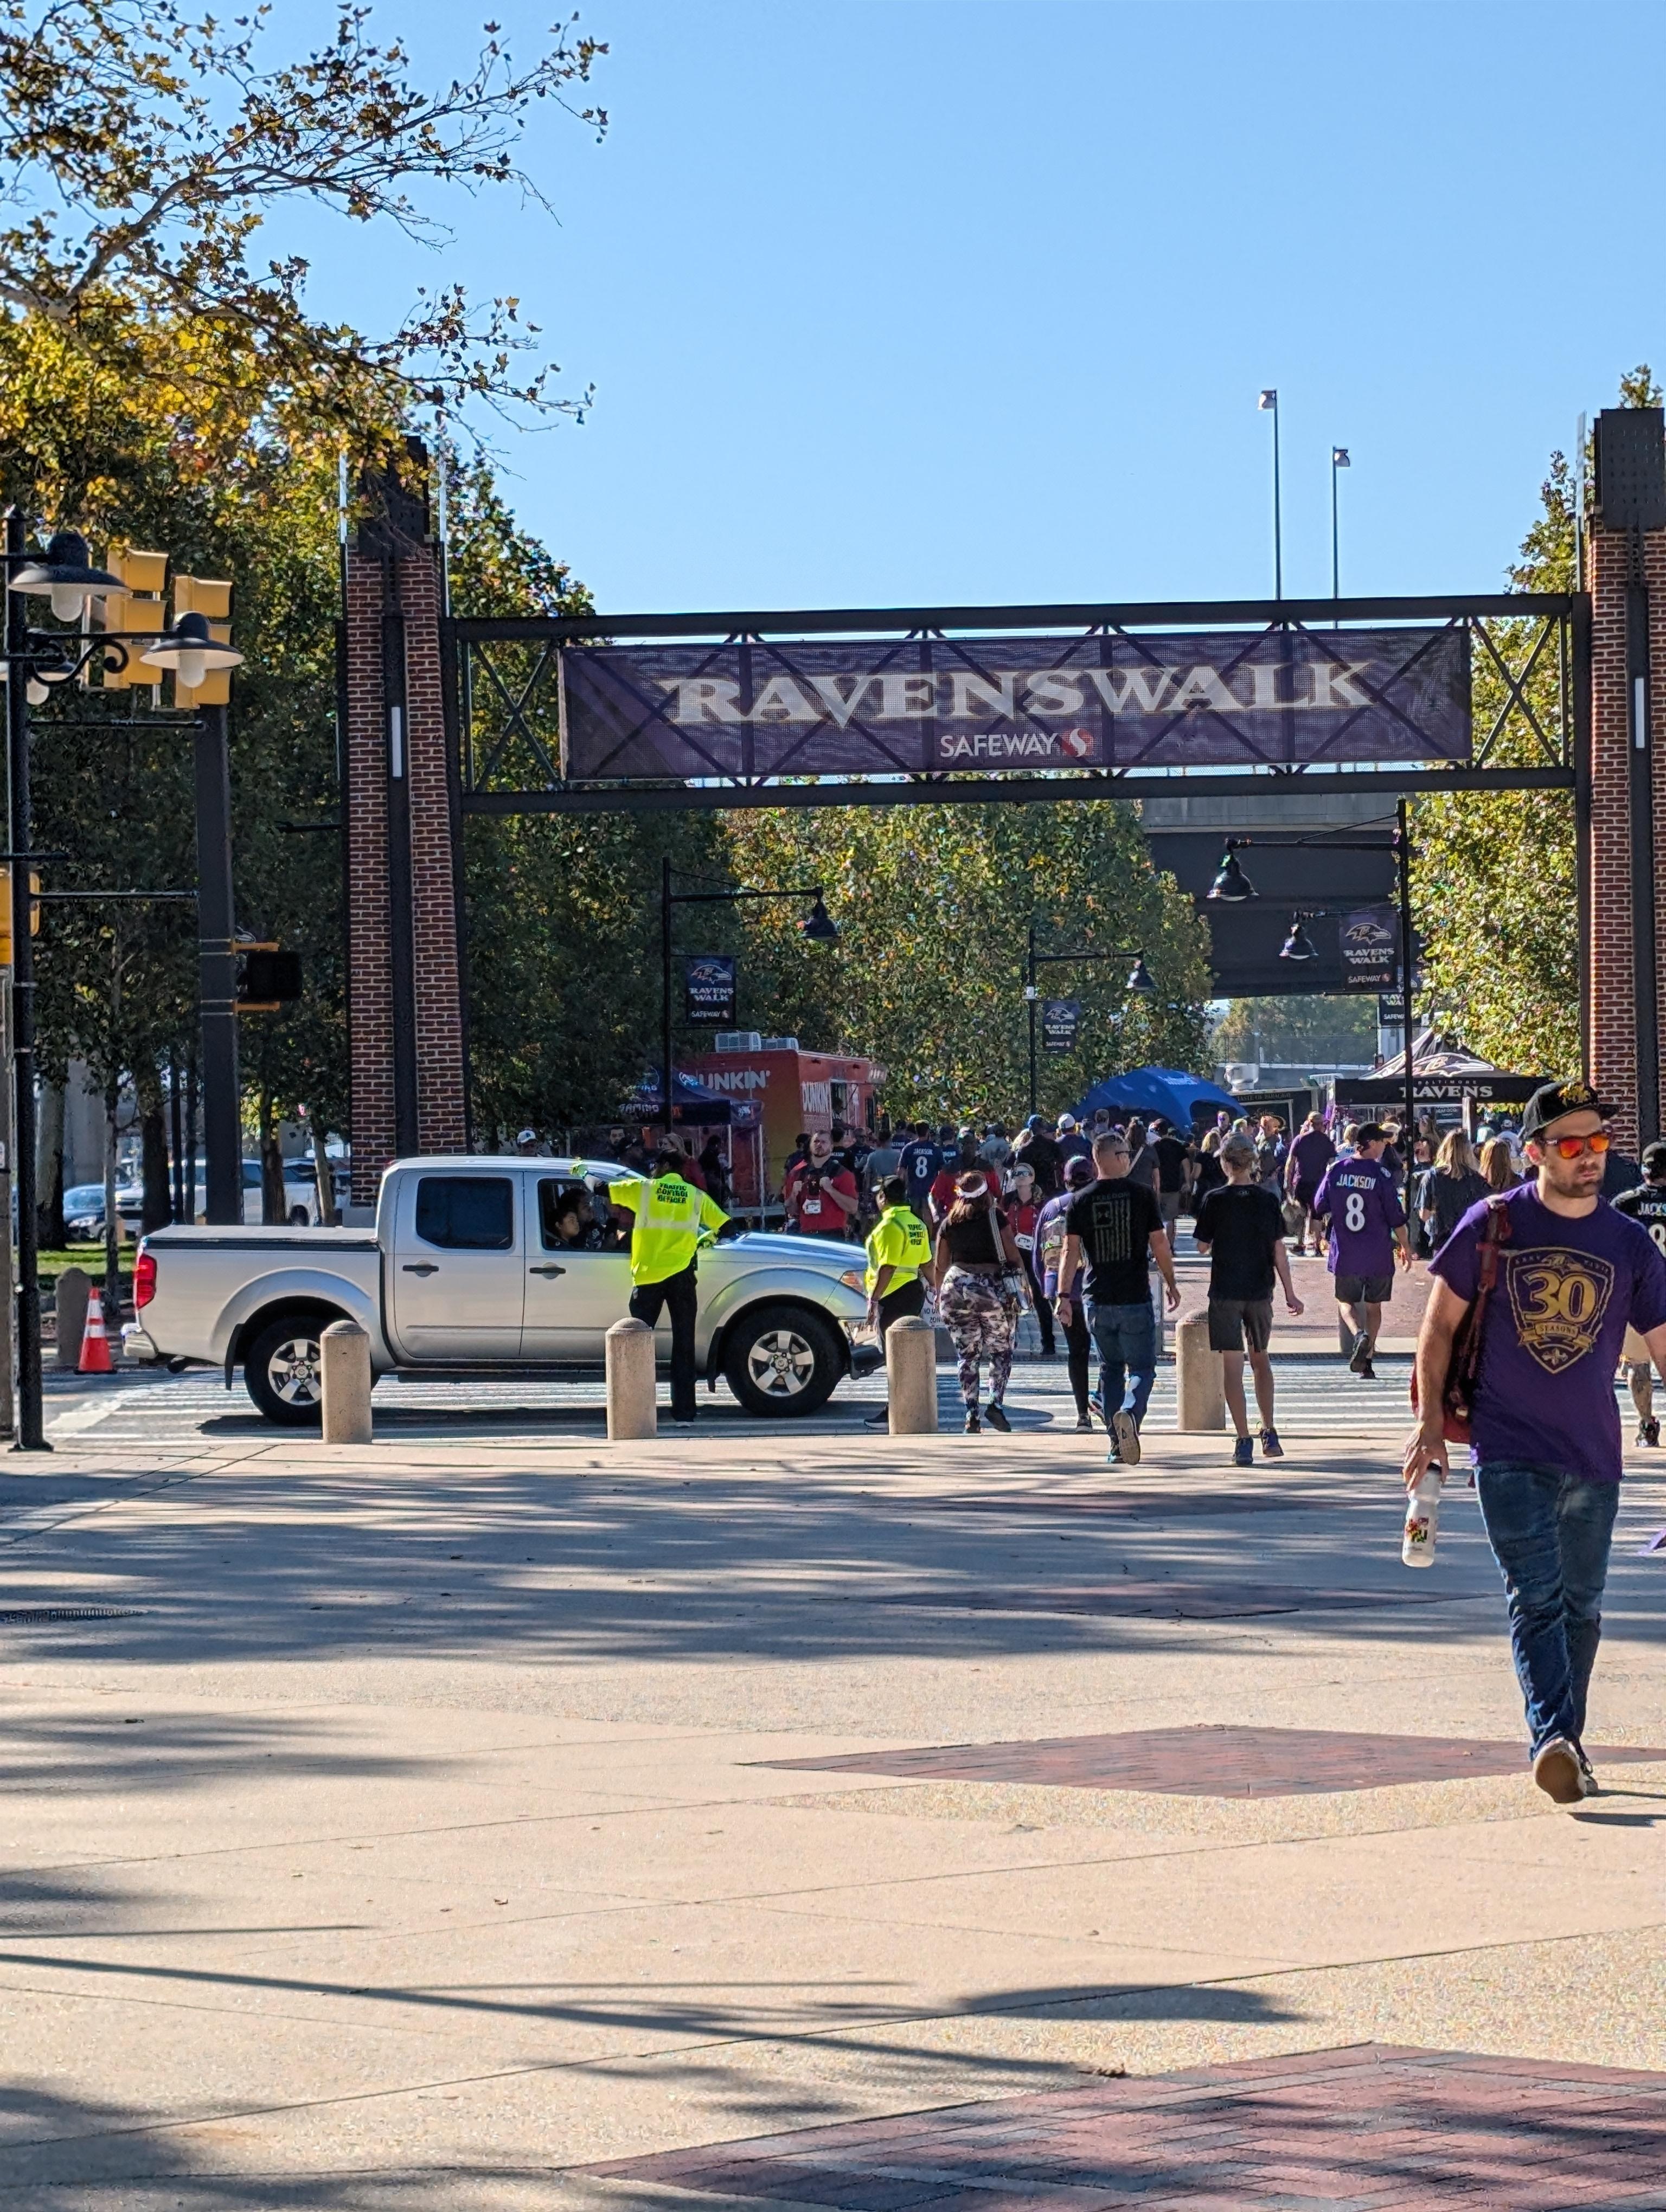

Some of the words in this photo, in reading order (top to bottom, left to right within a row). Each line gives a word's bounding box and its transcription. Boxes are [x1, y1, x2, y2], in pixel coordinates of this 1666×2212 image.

[655, 662, 1376, 728] RAVENSWALK
[940, 732, 1058, 757] SAFEWAY
[1343, 948, 1395, 957] RAVENS
[1348, 956, 1390, 964] WALK
[1348, 975, 1381, 983] SAFEWAY
[699, 1070, 771, 1091] UNKIN'
[915, 1155, 927, 1178] 8
[1336, 1174, 1376, 1190] JACKSON
[1345, 1193, 1366, 1232] 8
[1522, 1269, 1599, 1324] 30
[1540, 1324, 1576, 1334] SEASONS
